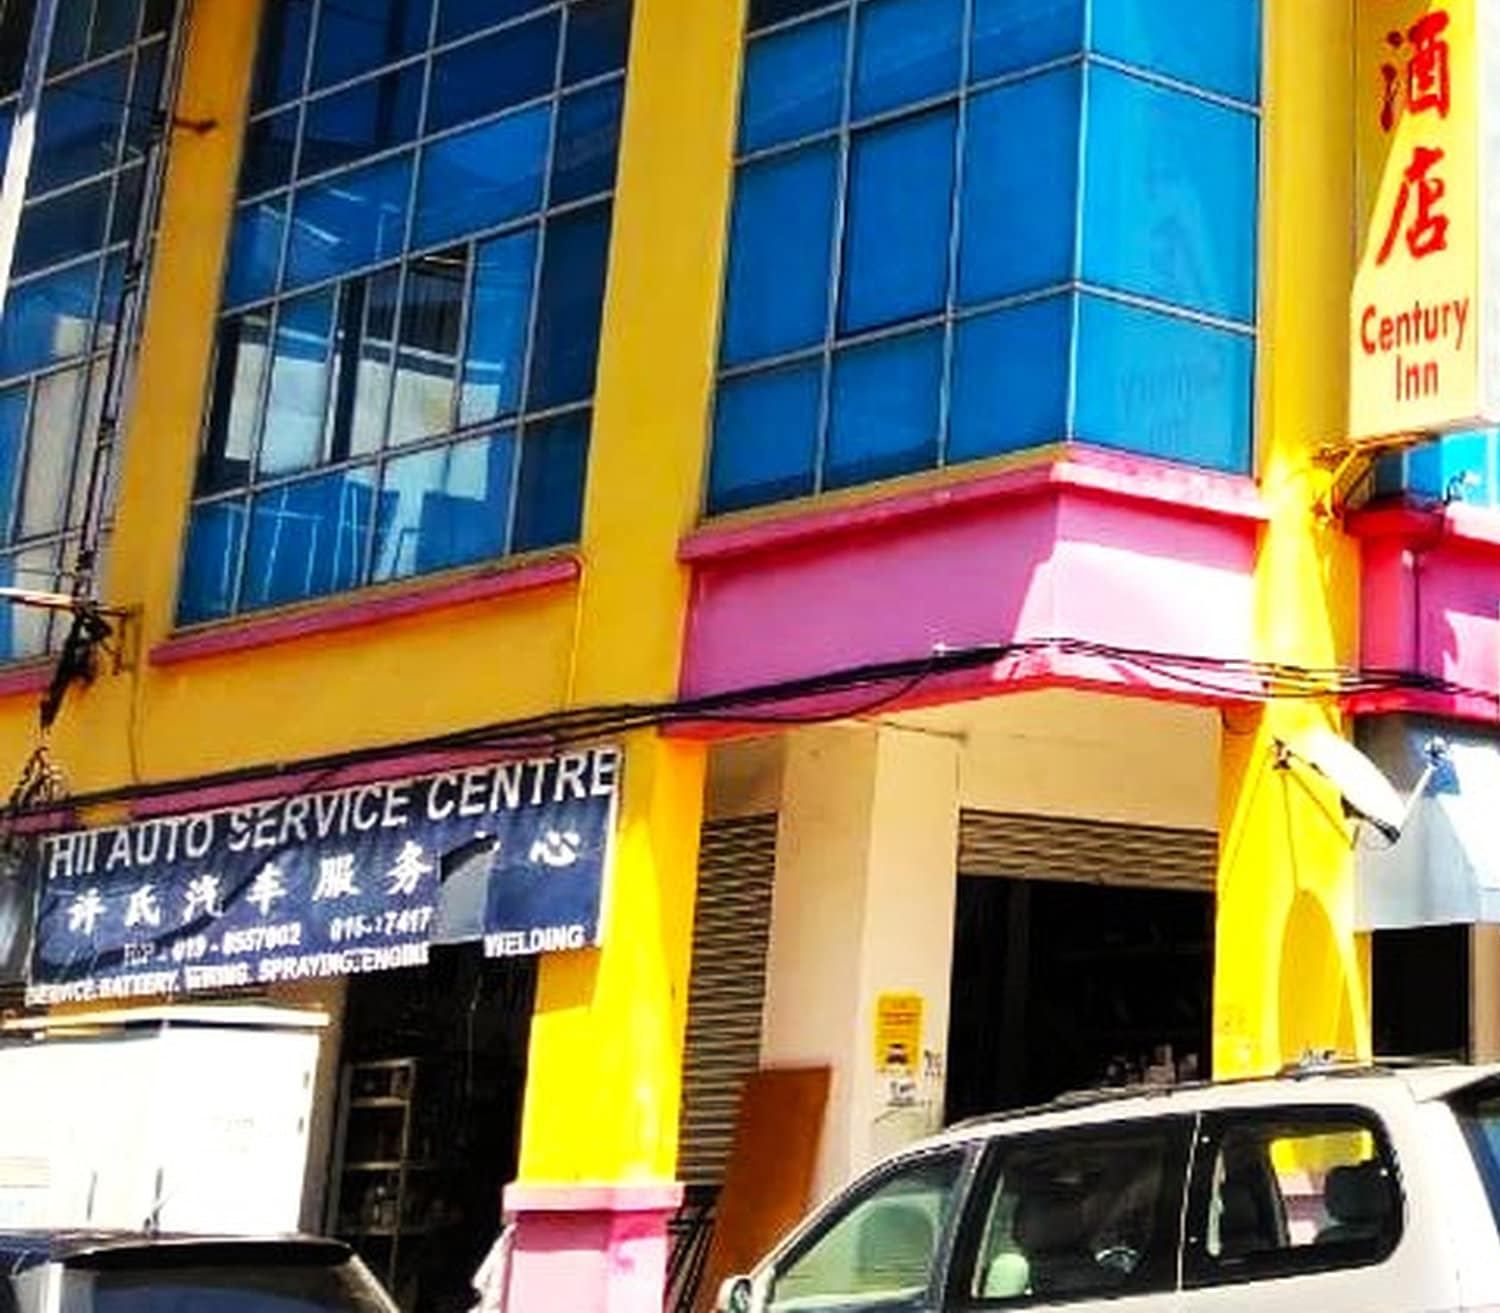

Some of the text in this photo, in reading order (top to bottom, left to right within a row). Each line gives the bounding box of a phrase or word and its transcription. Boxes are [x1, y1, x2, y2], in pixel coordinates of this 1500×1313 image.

[1360, 295, 1470, 356] Century
[1396, 353, 1439, 402] Inn
[48, 744, 621, 880] HII AUTO SERVICE CENTRE
[483, 924, 586, 958] WELDING
